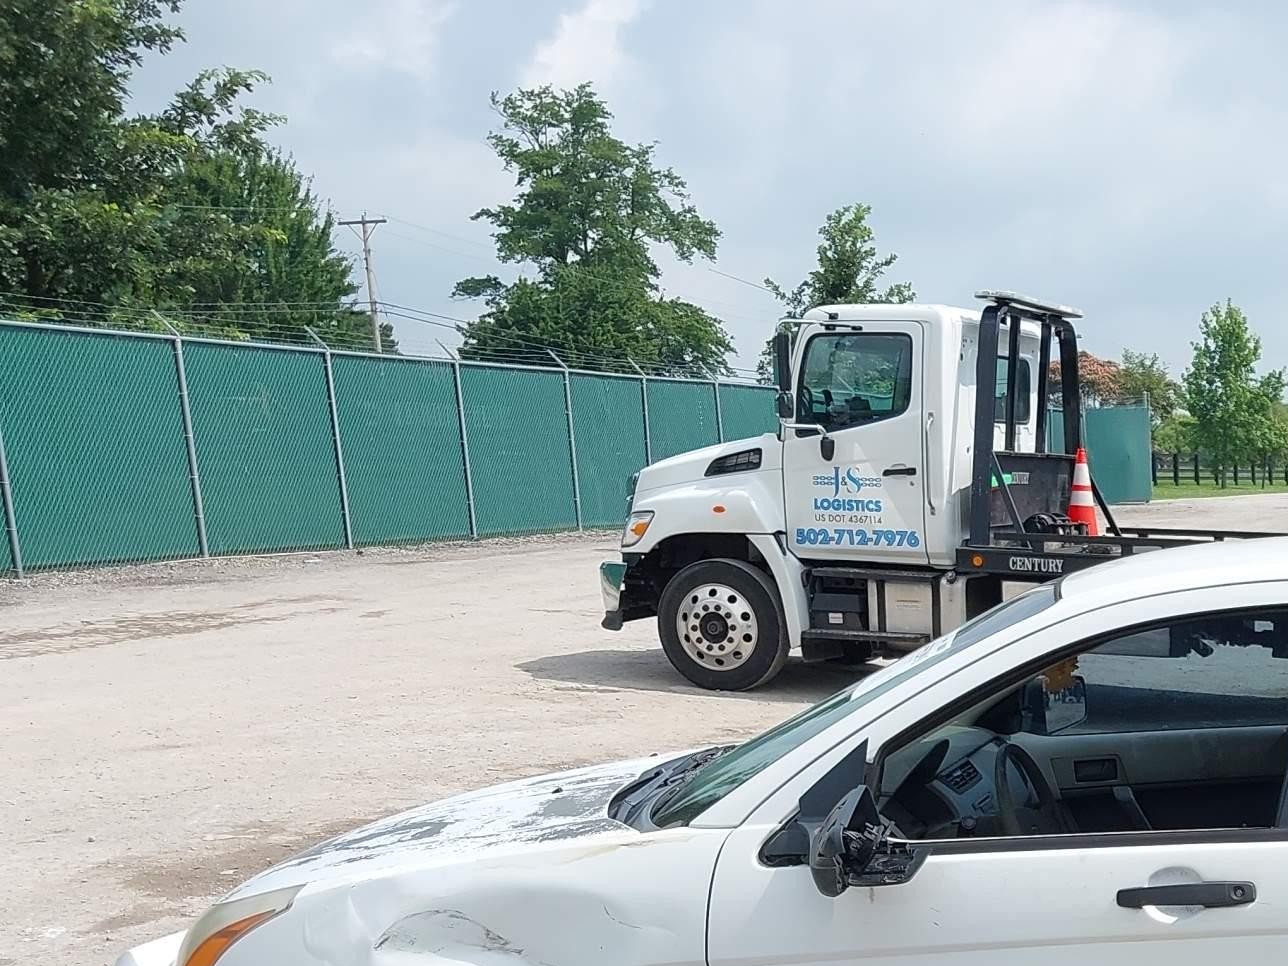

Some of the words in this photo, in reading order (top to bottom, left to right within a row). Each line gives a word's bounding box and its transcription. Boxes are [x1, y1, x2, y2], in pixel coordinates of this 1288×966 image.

[814, 498, 882, 512] LOGISTICS
[815, 514, 826, 522] US
[828, 514, 846, 523] DOT
[848, 515, 882, 524] 4367114
[796, 528, 920, 547] 502-712-7976
[1009, 556, 1064, 573] CENTURY
